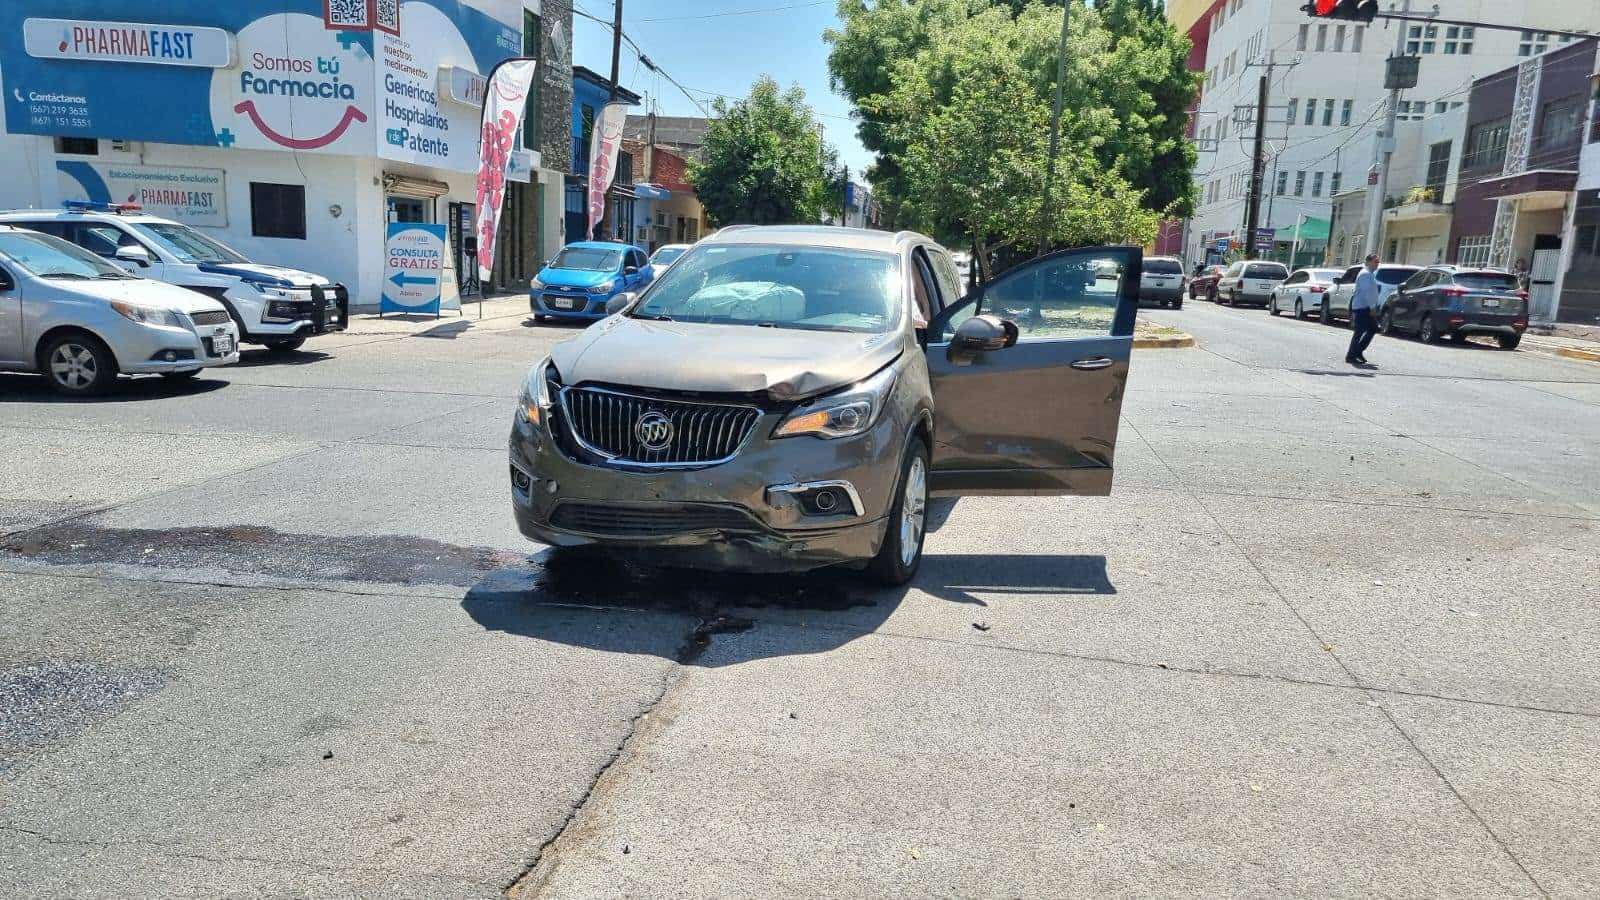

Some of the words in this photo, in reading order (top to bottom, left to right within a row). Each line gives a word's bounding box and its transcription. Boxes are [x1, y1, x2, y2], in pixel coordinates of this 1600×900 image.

[73, 26, 194, 59] PHARMAFAST
[253, 52, 312, 73] Somos
[317, 56, 340, 75] tú
[240, 70, 355, 100] farmacia
[385, 73, 438, 107] Genéricos,
[385, 98, 449, 131] Hospitalarios
[401, 127, 449, 157] Patente
[180, 173, 219, 184] Exclusivo
[141, 188, 215, 208] PHARMAFAST
[389, 257, 439, 270] GRATIS
[390, 248, 439, 258] CONSULTA
